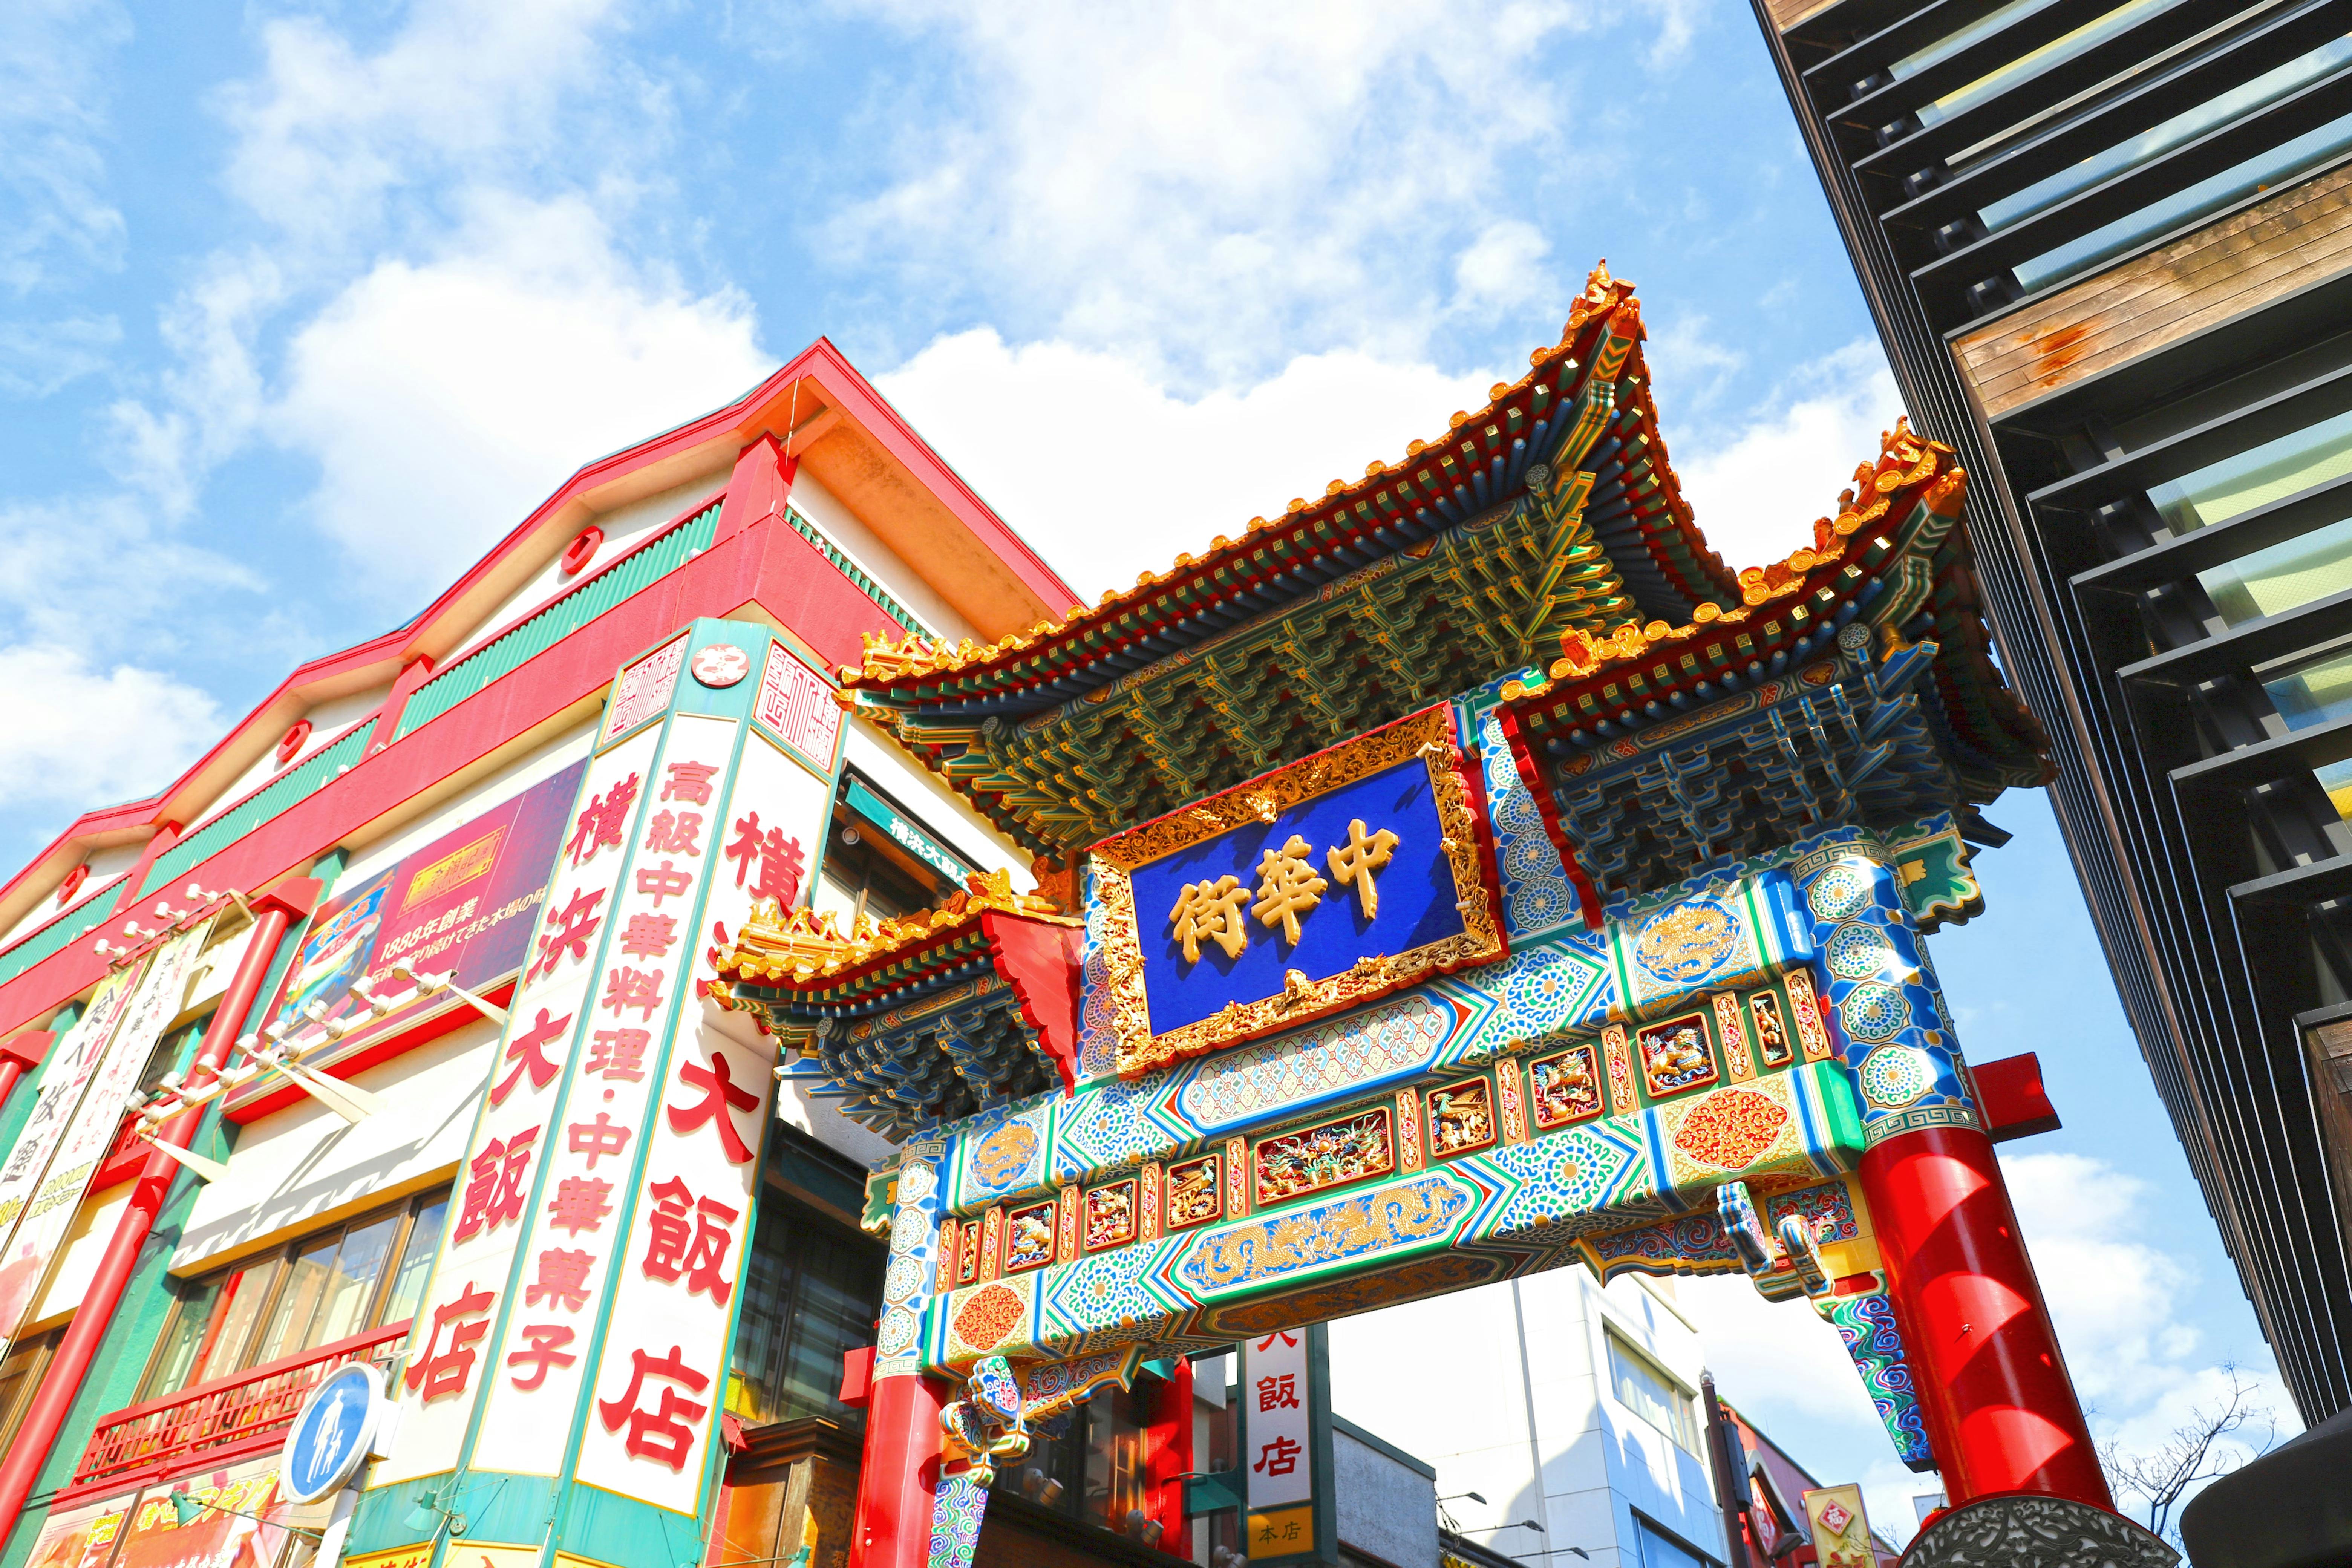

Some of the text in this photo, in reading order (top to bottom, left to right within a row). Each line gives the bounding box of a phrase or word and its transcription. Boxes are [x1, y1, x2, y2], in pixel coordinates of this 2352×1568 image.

[371, 883, 547, 984] 伝統守り続けてきた本場の味
[379, 896, 479, 963] 1888年創業
[1168, 817, 1400, 965] 中華街
[1, 987, 115, 1185] 食べ放題
[406, 772, 640, 1402] 横浜大飯店
[508, 760, 719, 1391] 高級中華料理・中華菓子
[599, 811, 806, 1471] 横大飯店
[1259, 1521, 1302, 1544] 本店
[1827, 1507, 1844, 1526] 福
